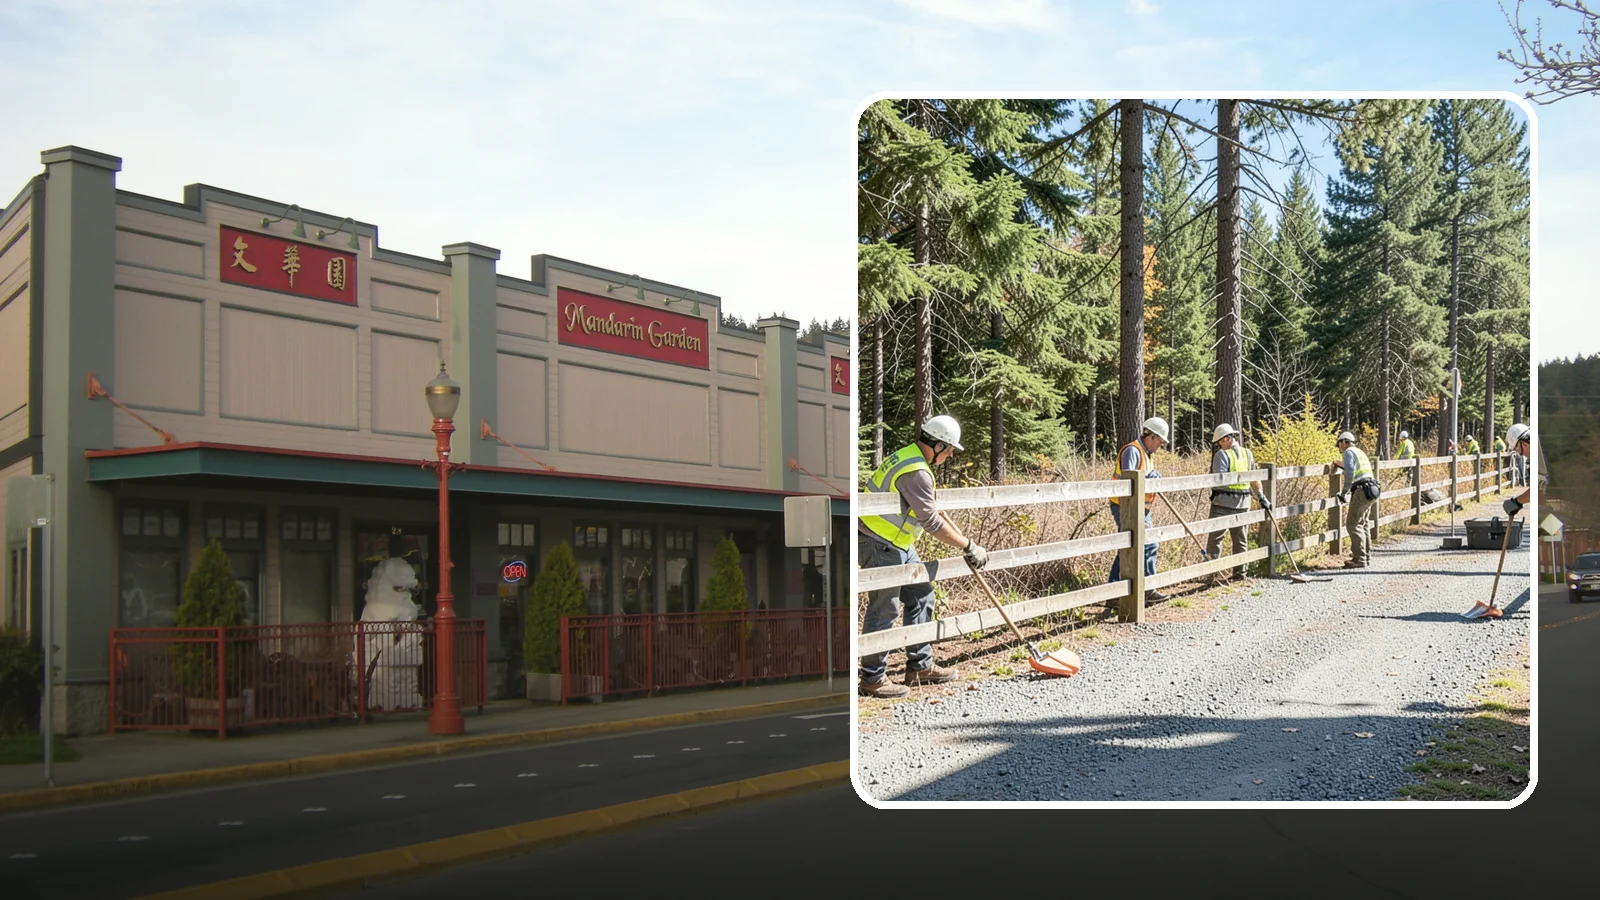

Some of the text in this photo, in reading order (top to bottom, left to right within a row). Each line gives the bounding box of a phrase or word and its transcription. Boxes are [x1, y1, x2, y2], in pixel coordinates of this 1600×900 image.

[230, 235, 346, 291] 文華園
[564, 302, 701, 352] Mandarin Garden
[503, 565, 527, 578] OPEN
